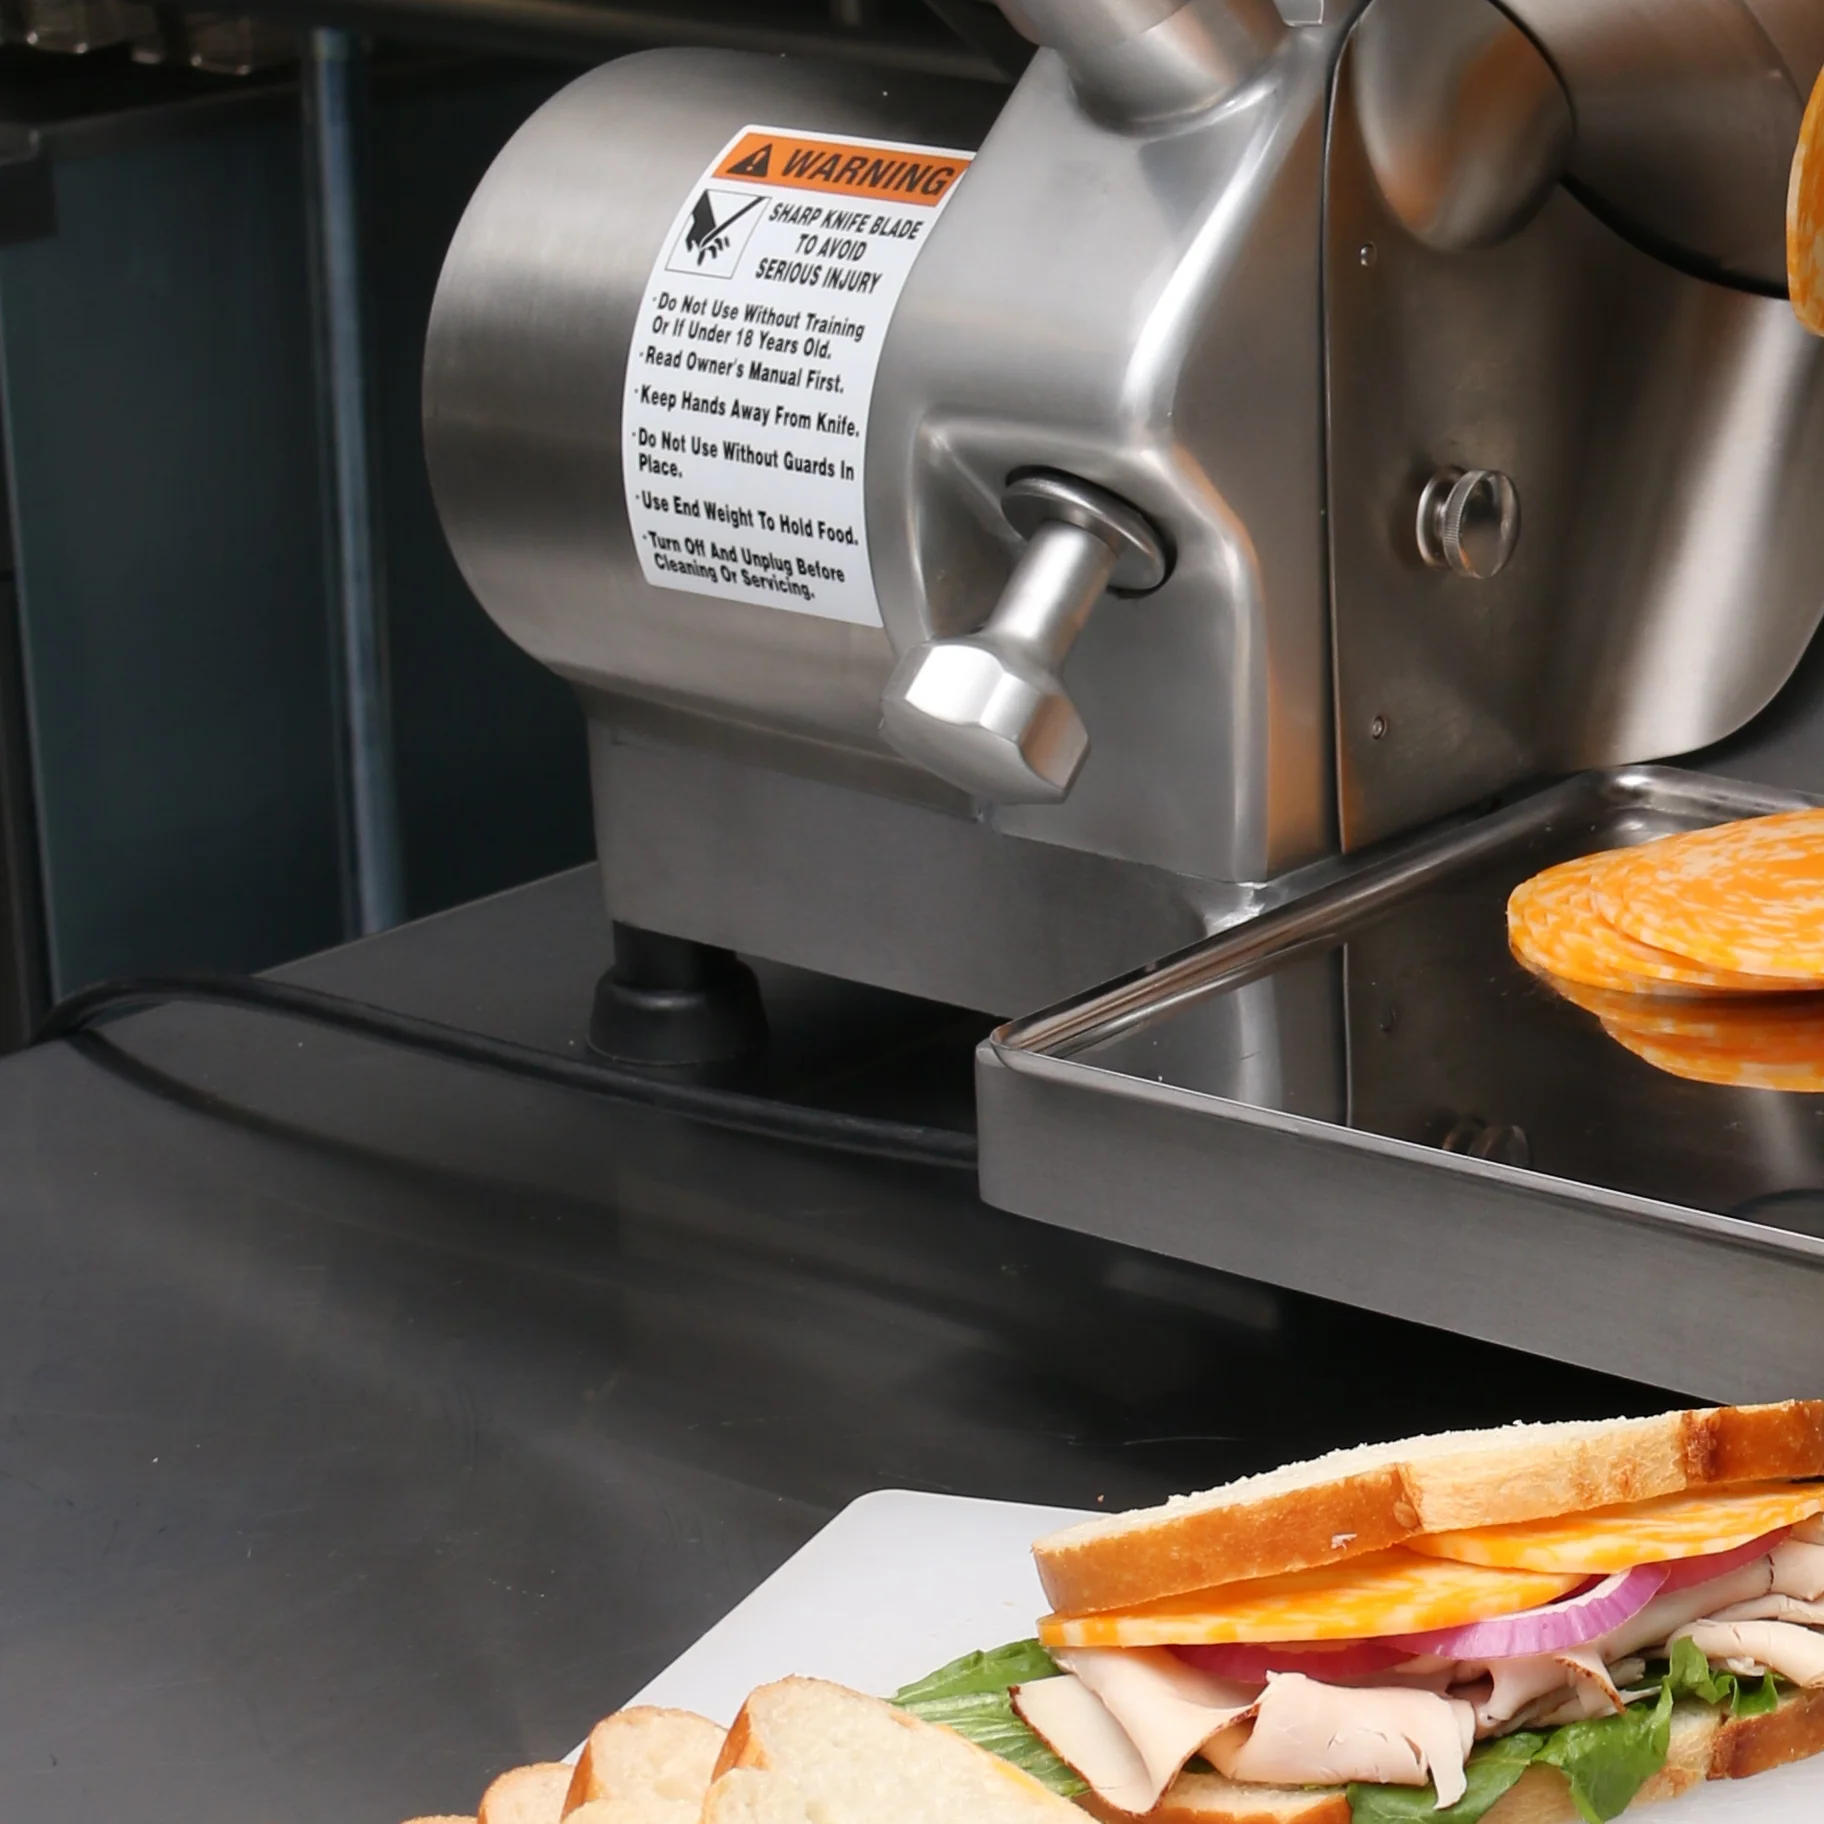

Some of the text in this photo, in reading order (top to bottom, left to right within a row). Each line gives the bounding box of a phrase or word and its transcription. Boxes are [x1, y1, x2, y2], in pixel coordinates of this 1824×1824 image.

[781, 148, 955, 197] WARNING
[768, 202, 924, 240] SHARP KNIFE BLADE
[796, 234, 867, 262] TO AVOID
[755, 258, 883, 295] SERIOUS INJURY
[652, 315, 832, 359] Or If Under 18 Years Old.
[657, 292, 866, 342] Do Not Use Without Training
[645, 345, 844, 394] Read Owner's Manual First.
[640, 384, 860, 438] Keep Hands Away From Knife.
[638, 427, 855, 480] Do Not Use Without Guards In
[638, 453, 683, 478] Place.
[641, 490, 859, 546] Use End Weight To Hold Food.
[648, 531, 845, 583] Turn Off And Unplug Before
[654, 552, 815, 600] Cleaning Or Servicing.
